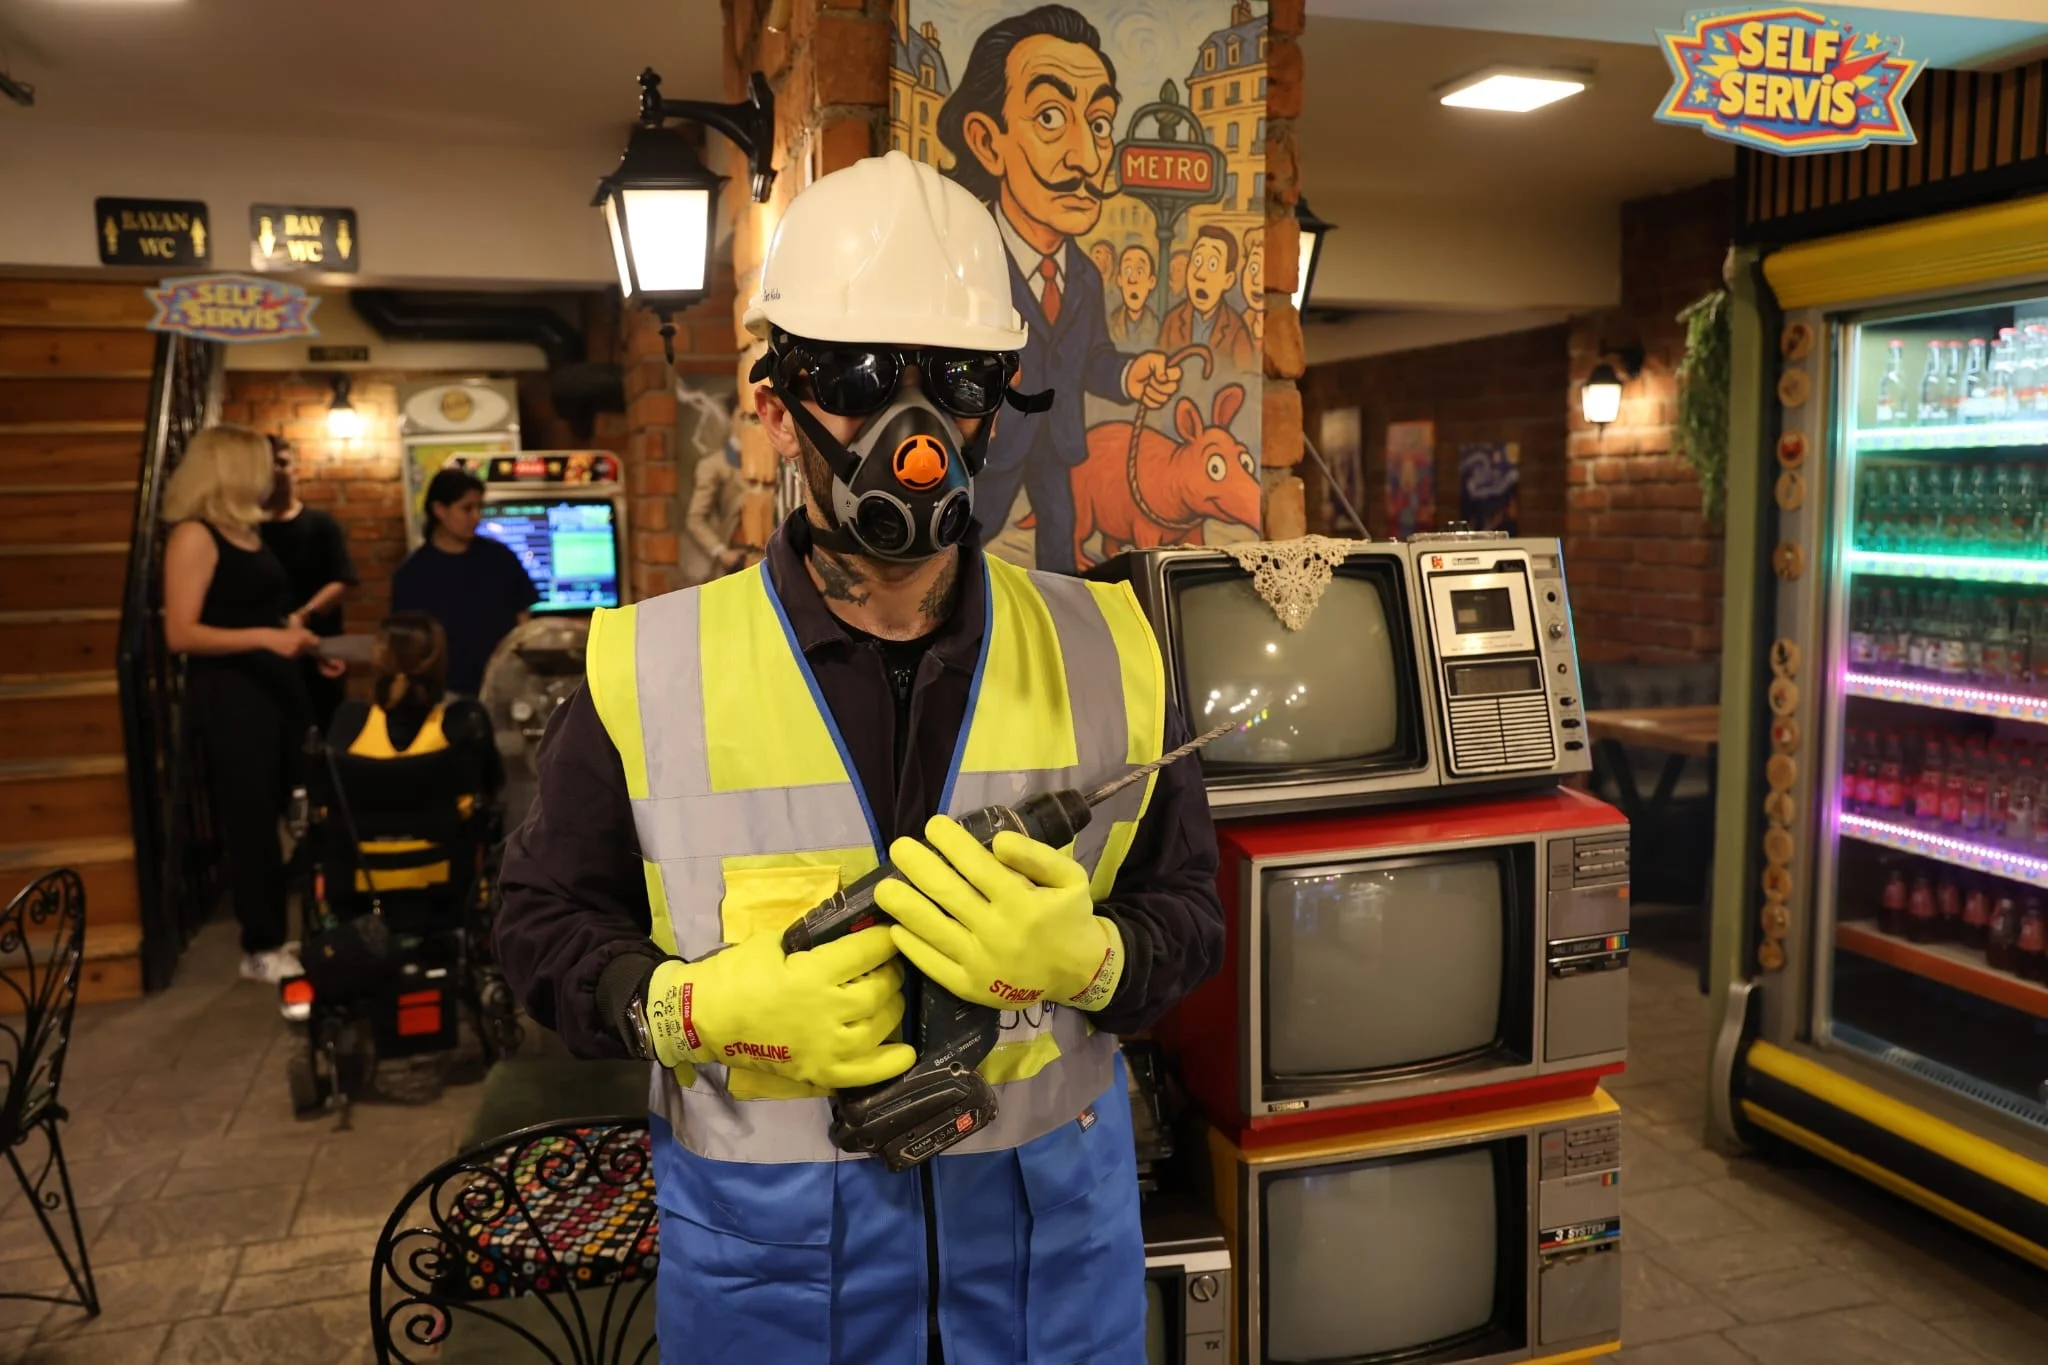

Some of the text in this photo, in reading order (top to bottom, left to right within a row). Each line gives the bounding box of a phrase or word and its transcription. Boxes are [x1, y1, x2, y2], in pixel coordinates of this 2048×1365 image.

[1738, 21, 1840, 73] SELF
[1126, 153, 1208, 182] METRO
[120, 210, 189, 232] BAYAN
[284, 214, 324, 236] BAY
[138, 237, 176, 258] WC
[286, 240, 323, 262] WC
[196, 284, 264, 306] SELF
[724, 1042, 792, 1060] STARLINE
